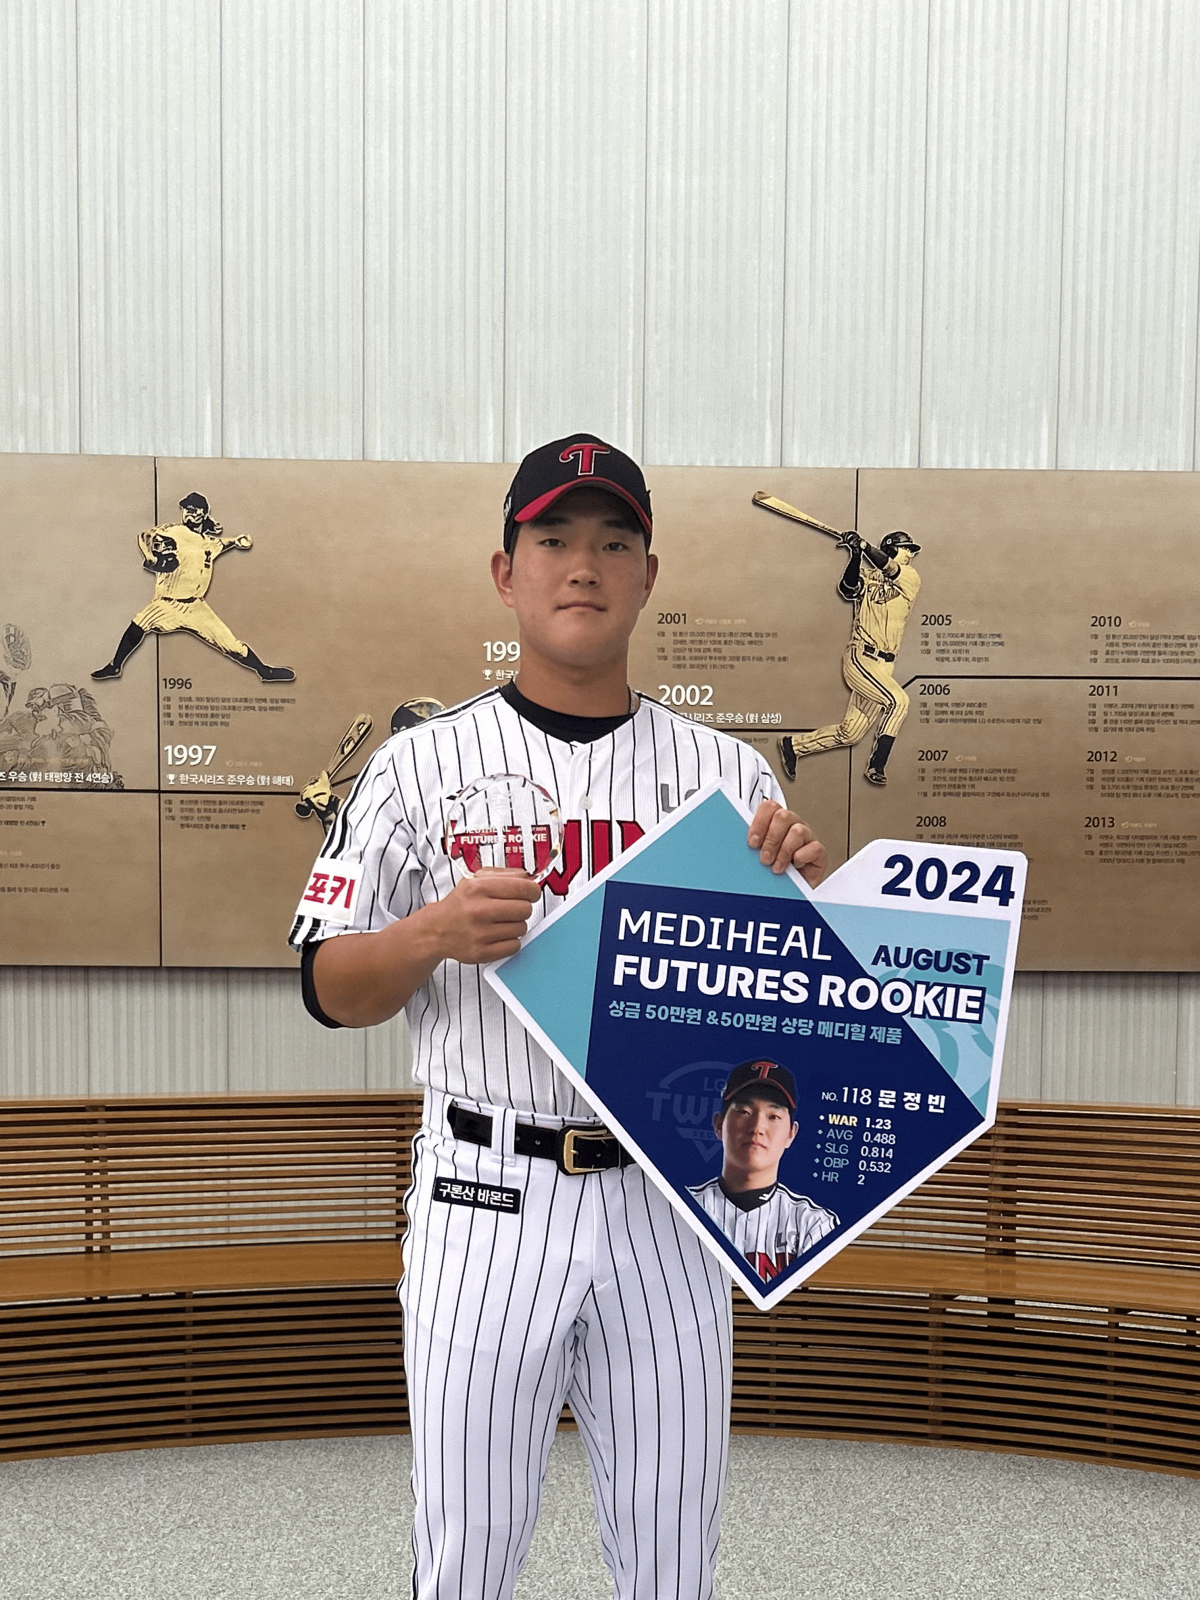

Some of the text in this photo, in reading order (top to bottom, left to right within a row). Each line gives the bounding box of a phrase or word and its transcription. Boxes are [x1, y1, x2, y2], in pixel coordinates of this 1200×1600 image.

[559, 443, 610, 476] T
[657, 612, 687, 625] 2001
[921, 614, 952, 626] 2005
[1090, 615, 1122, 627] 2010
[483, 641, 520, 662] 199
[162, 678, 193, 690] 1996
[919, 684, 951, 695] 2006
[1089, 685, 1118, 696] 2011
[658, 684, 714, 706] 2002
[716, 713, 744, 723] 준우승
[761, 713, 782, 724] 삼성)
[164, 745, 217, 766] 1997
[917, 749, 949, 761] 2007
[1086, 750, 1118, 762] 2012
[8, 771, 27, 782] 우승
[44, 771, 73, 783] 태평양
[74, 772, 84, 783] 전
[86, 772, 114, 784] 4연승)
[179, 773, 226, 785] 한국시리즈
[227, 774, 256, 786] 준우승
[272, 775, 295, 787] 해태)
[915, 815, 947, 828] 2008
[1084, 816, 1115, 828] 2013
[881, 854, 1015, 907] 2024
[304, 872, 356, 909] 포키
[618, 908, 832, 961] MEDIHEAL
[871, 944, 990, 976] AUGUST
[613, 954, 984, 1022] FUTURES ROOKIE
[609, 1000, 641, 1019] 상금
[645, 1004, 702, 1025] 50만원
[781, 1017, 814, 1036] 상당
[817, 1021, 866, 1041] 메디힐
[869, 1026, 903, 1045] 제품
[821, 1086, 946, 1114] NO. 118 문 정 빈
[828, 1114, 892, 1130] WAR 1.23
[826, 1128, 896, 1145] AVG 0.488
[824, 1142, 893, 1159] SLG 0.814
[823, 1156, 892, 1174] OBP 0.532
[821, 1171, 866, 1185] HR 2
[439, 1182, 514, 1208] 구론산 바몬드
